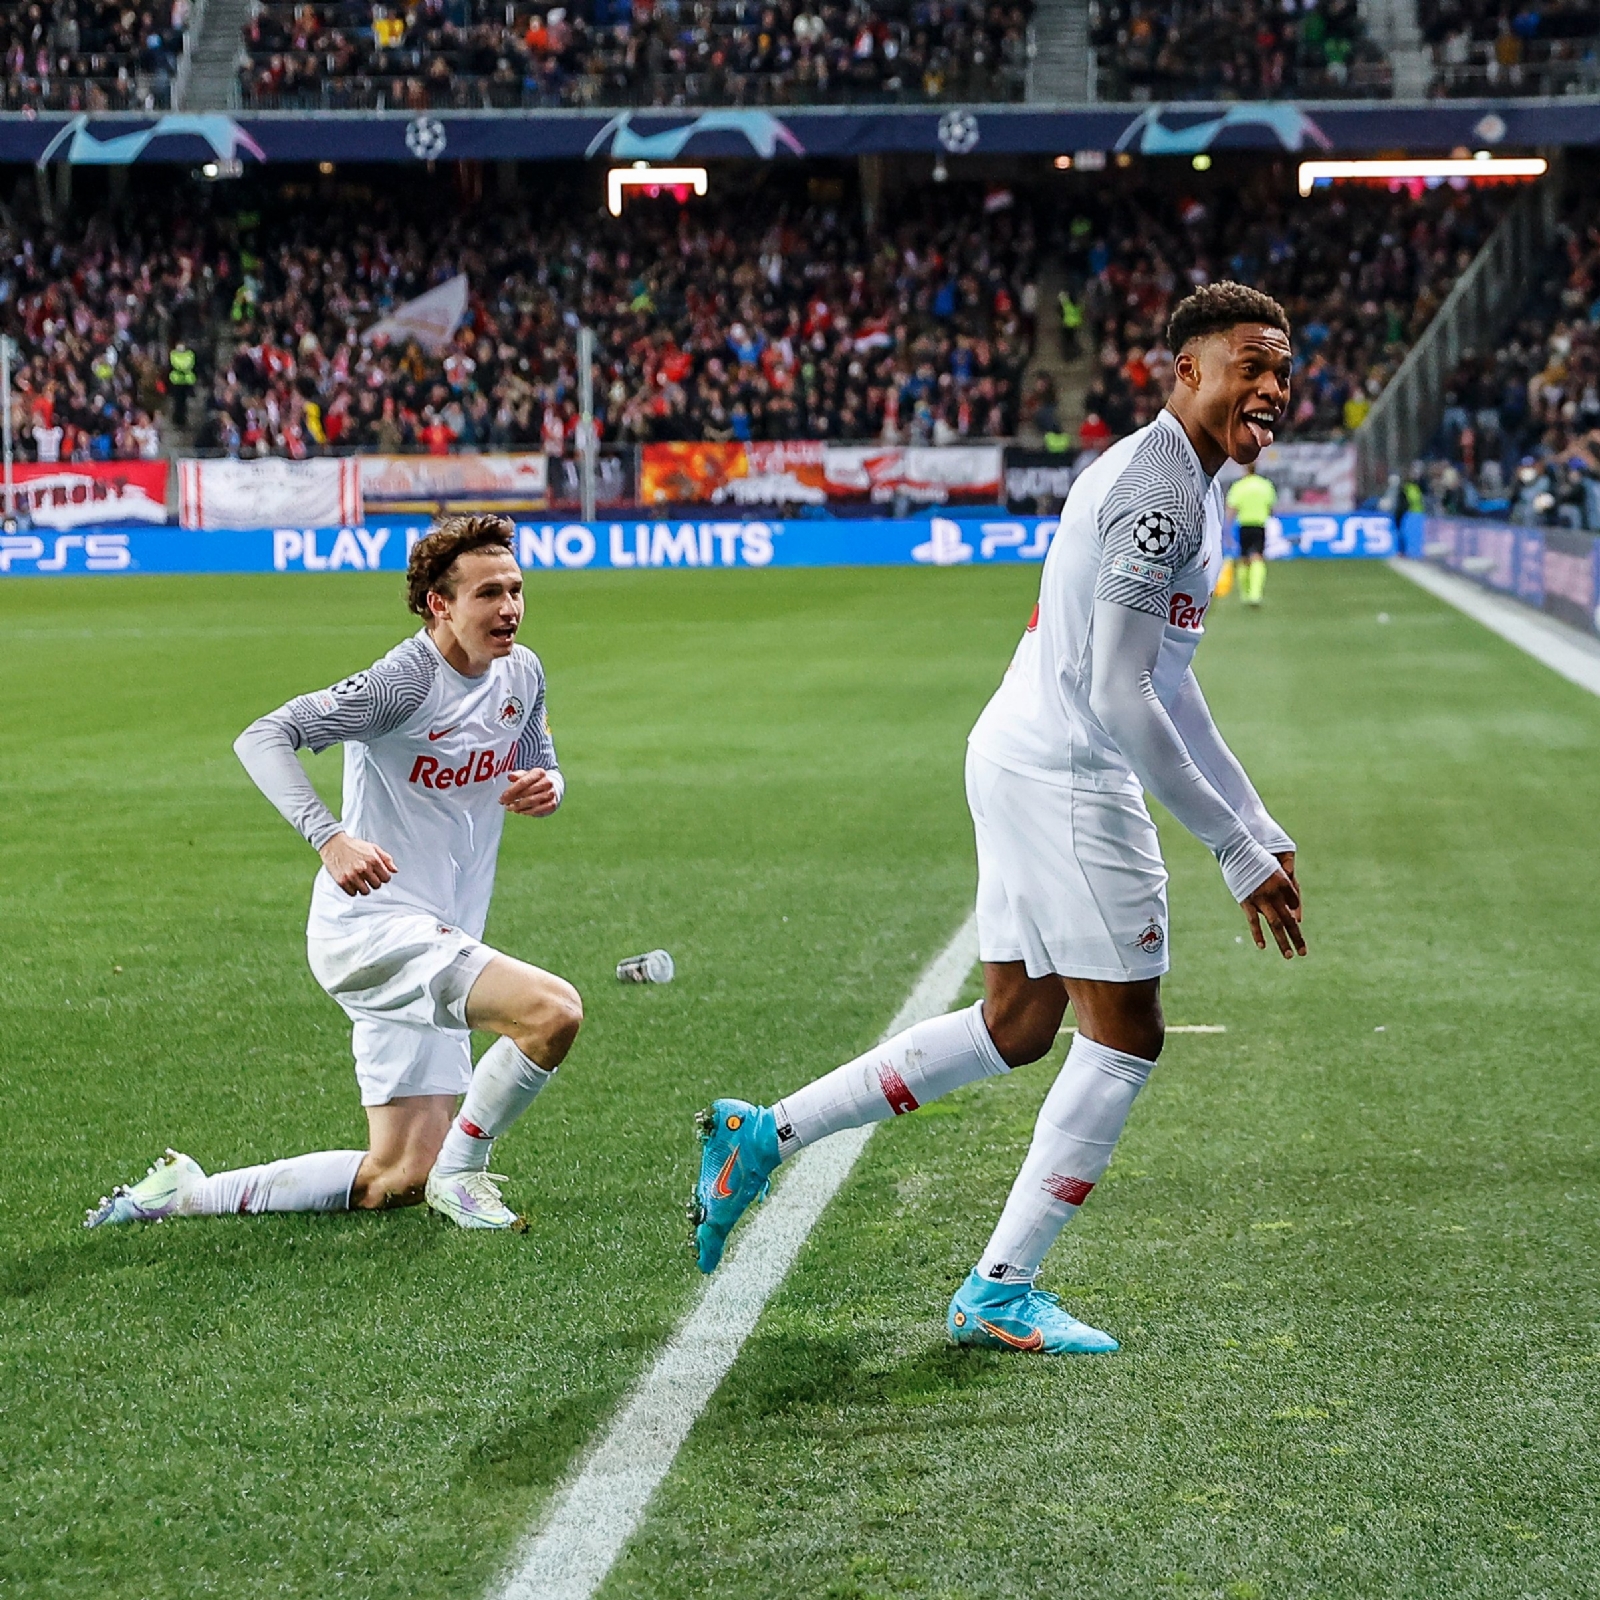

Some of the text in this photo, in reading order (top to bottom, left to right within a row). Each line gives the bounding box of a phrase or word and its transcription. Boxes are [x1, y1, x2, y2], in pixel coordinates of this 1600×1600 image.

[0, 534, 131, 572] PS5
[273, 528, 391, 570] PLAY
[518, 524, 596, 568] NO
[609, 521, 775, 567] LIMITS
[980, 521, 1061, 559] PS
[1298, 516, 1393, 554] PS5
[1115, 560, 1171, 581] FOUNDATION
[409, 740, 519, 789] Red Bull
